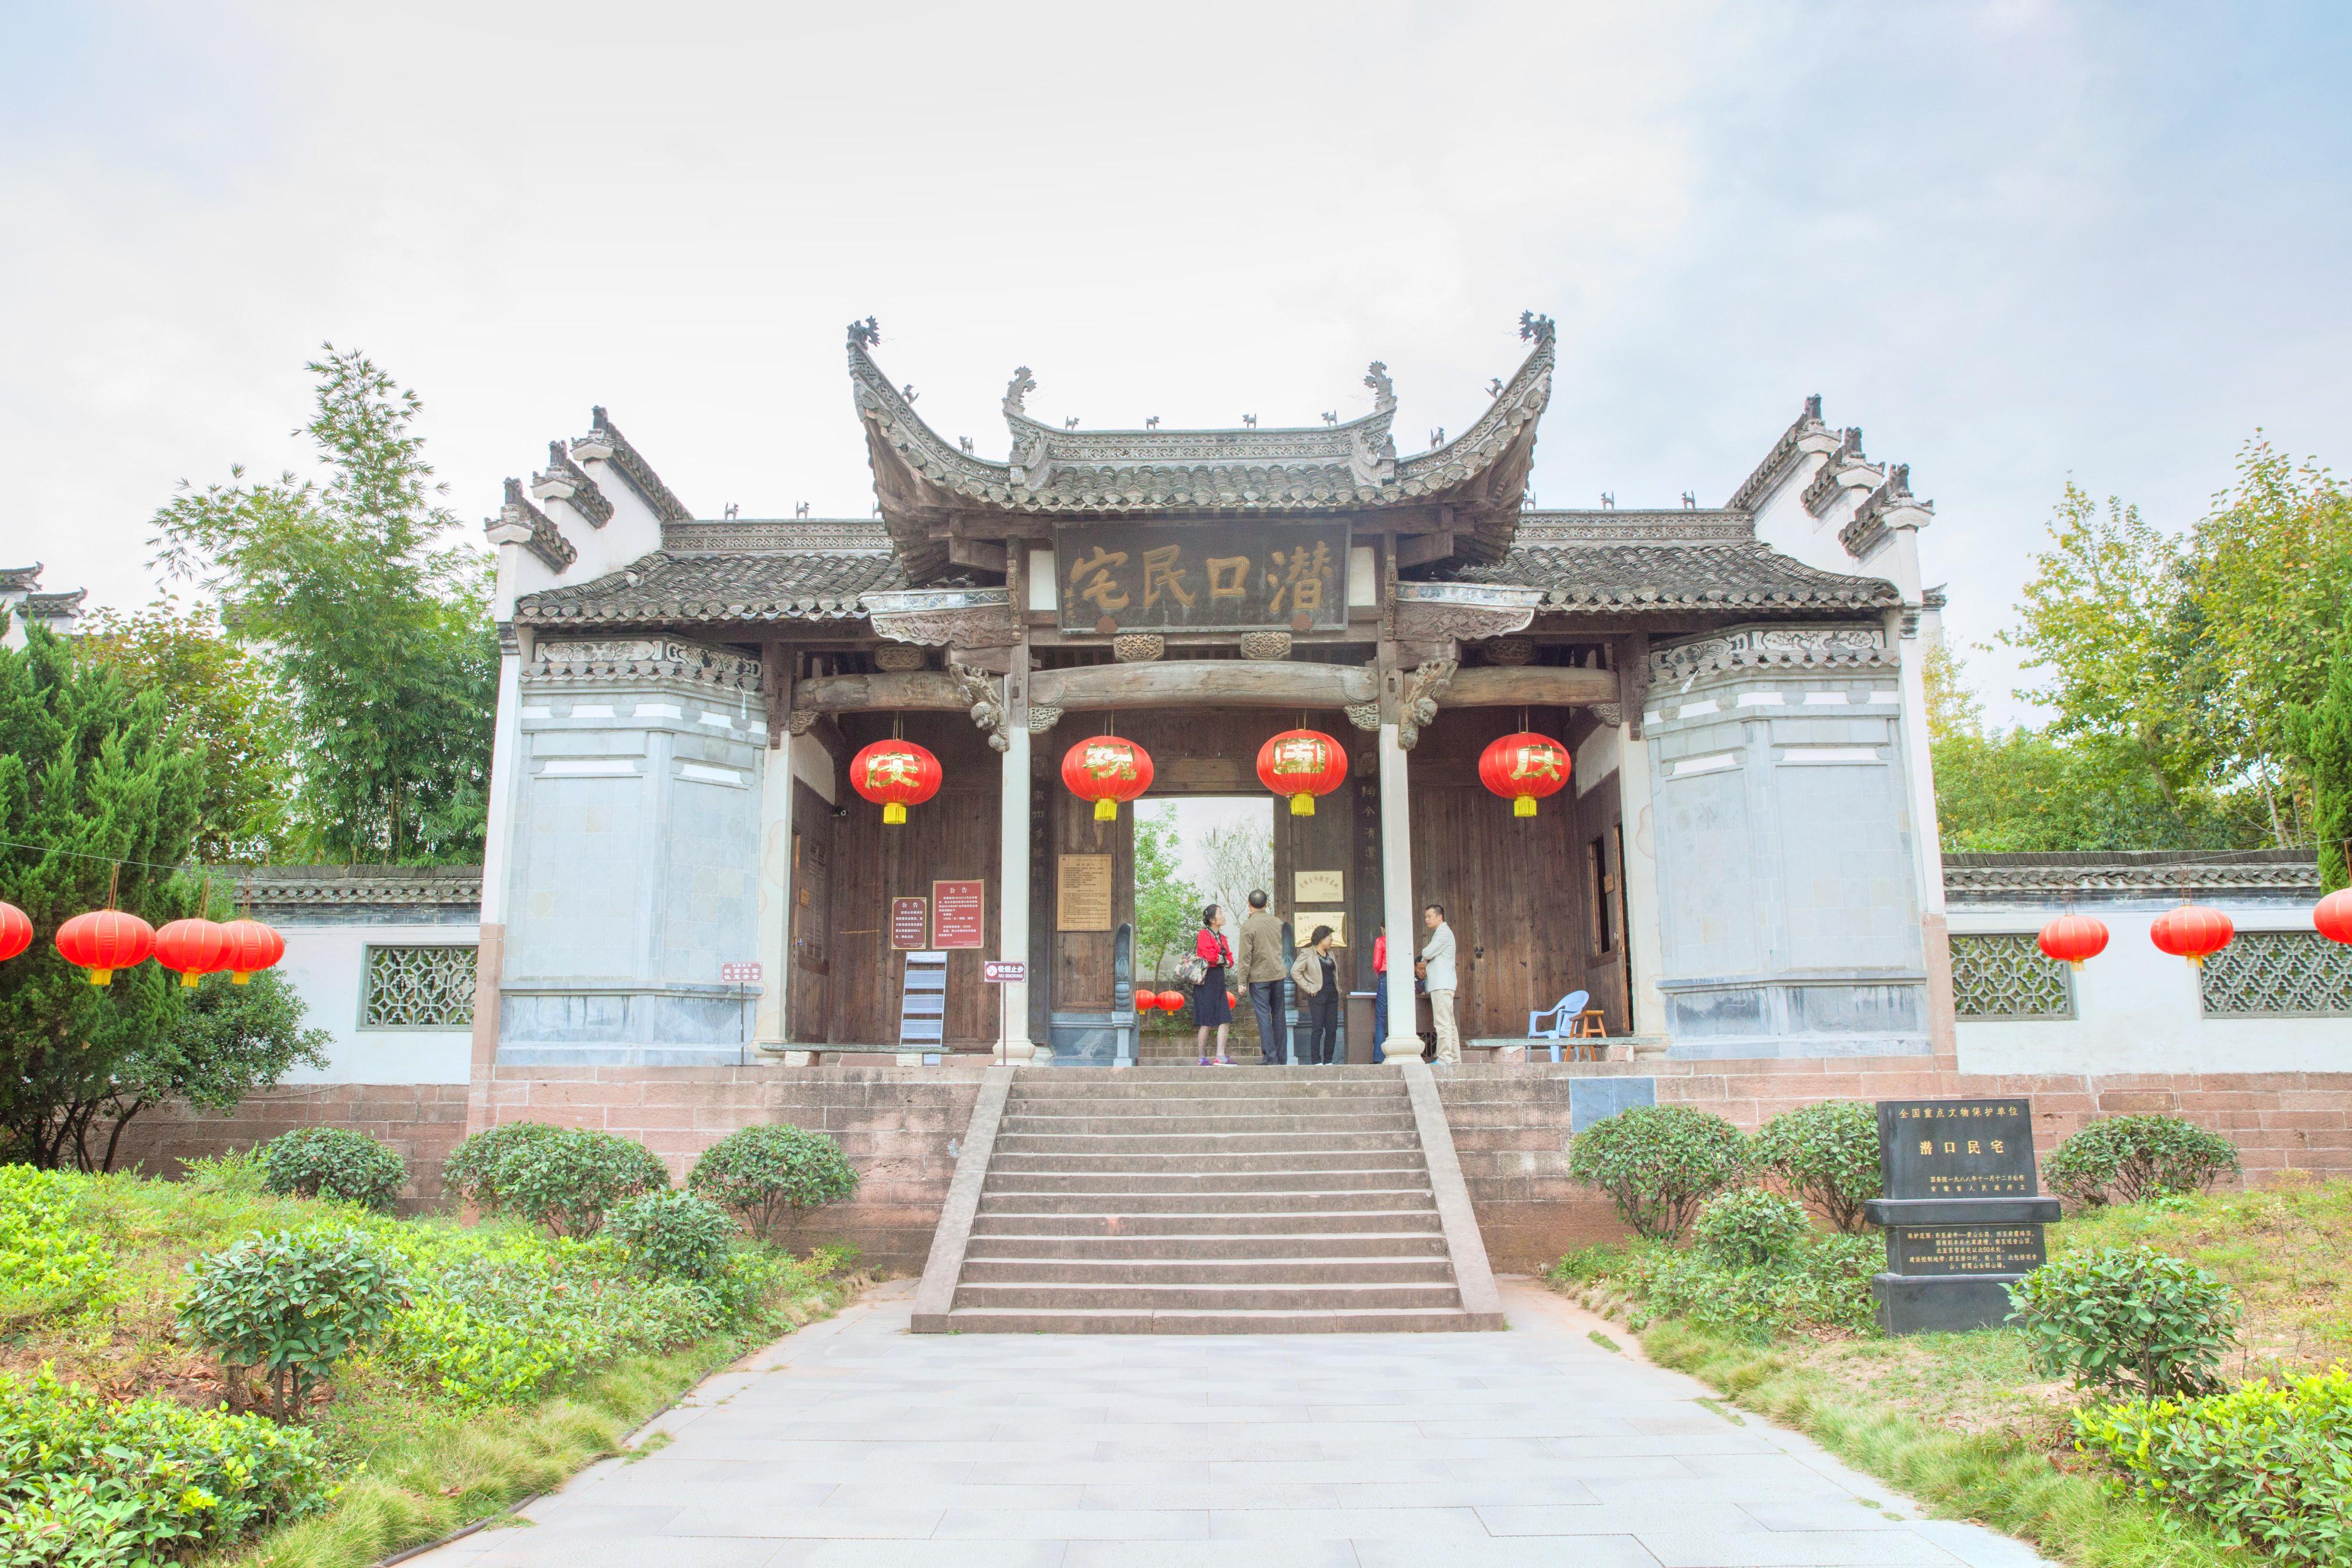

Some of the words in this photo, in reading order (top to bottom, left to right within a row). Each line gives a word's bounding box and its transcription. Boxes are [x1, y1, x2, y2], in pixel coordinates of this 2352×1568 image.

[1083, 744, 1137, 781] 祝
[1273, 738, 1325, 775] 国
[1899, 1106, 2019, 1118] 全国重点文物保护单位
[1920, 1139, 2004, 1155] 潜口民宅
[1930, 1184, 2026, 1192] 安徽省人民政府立
